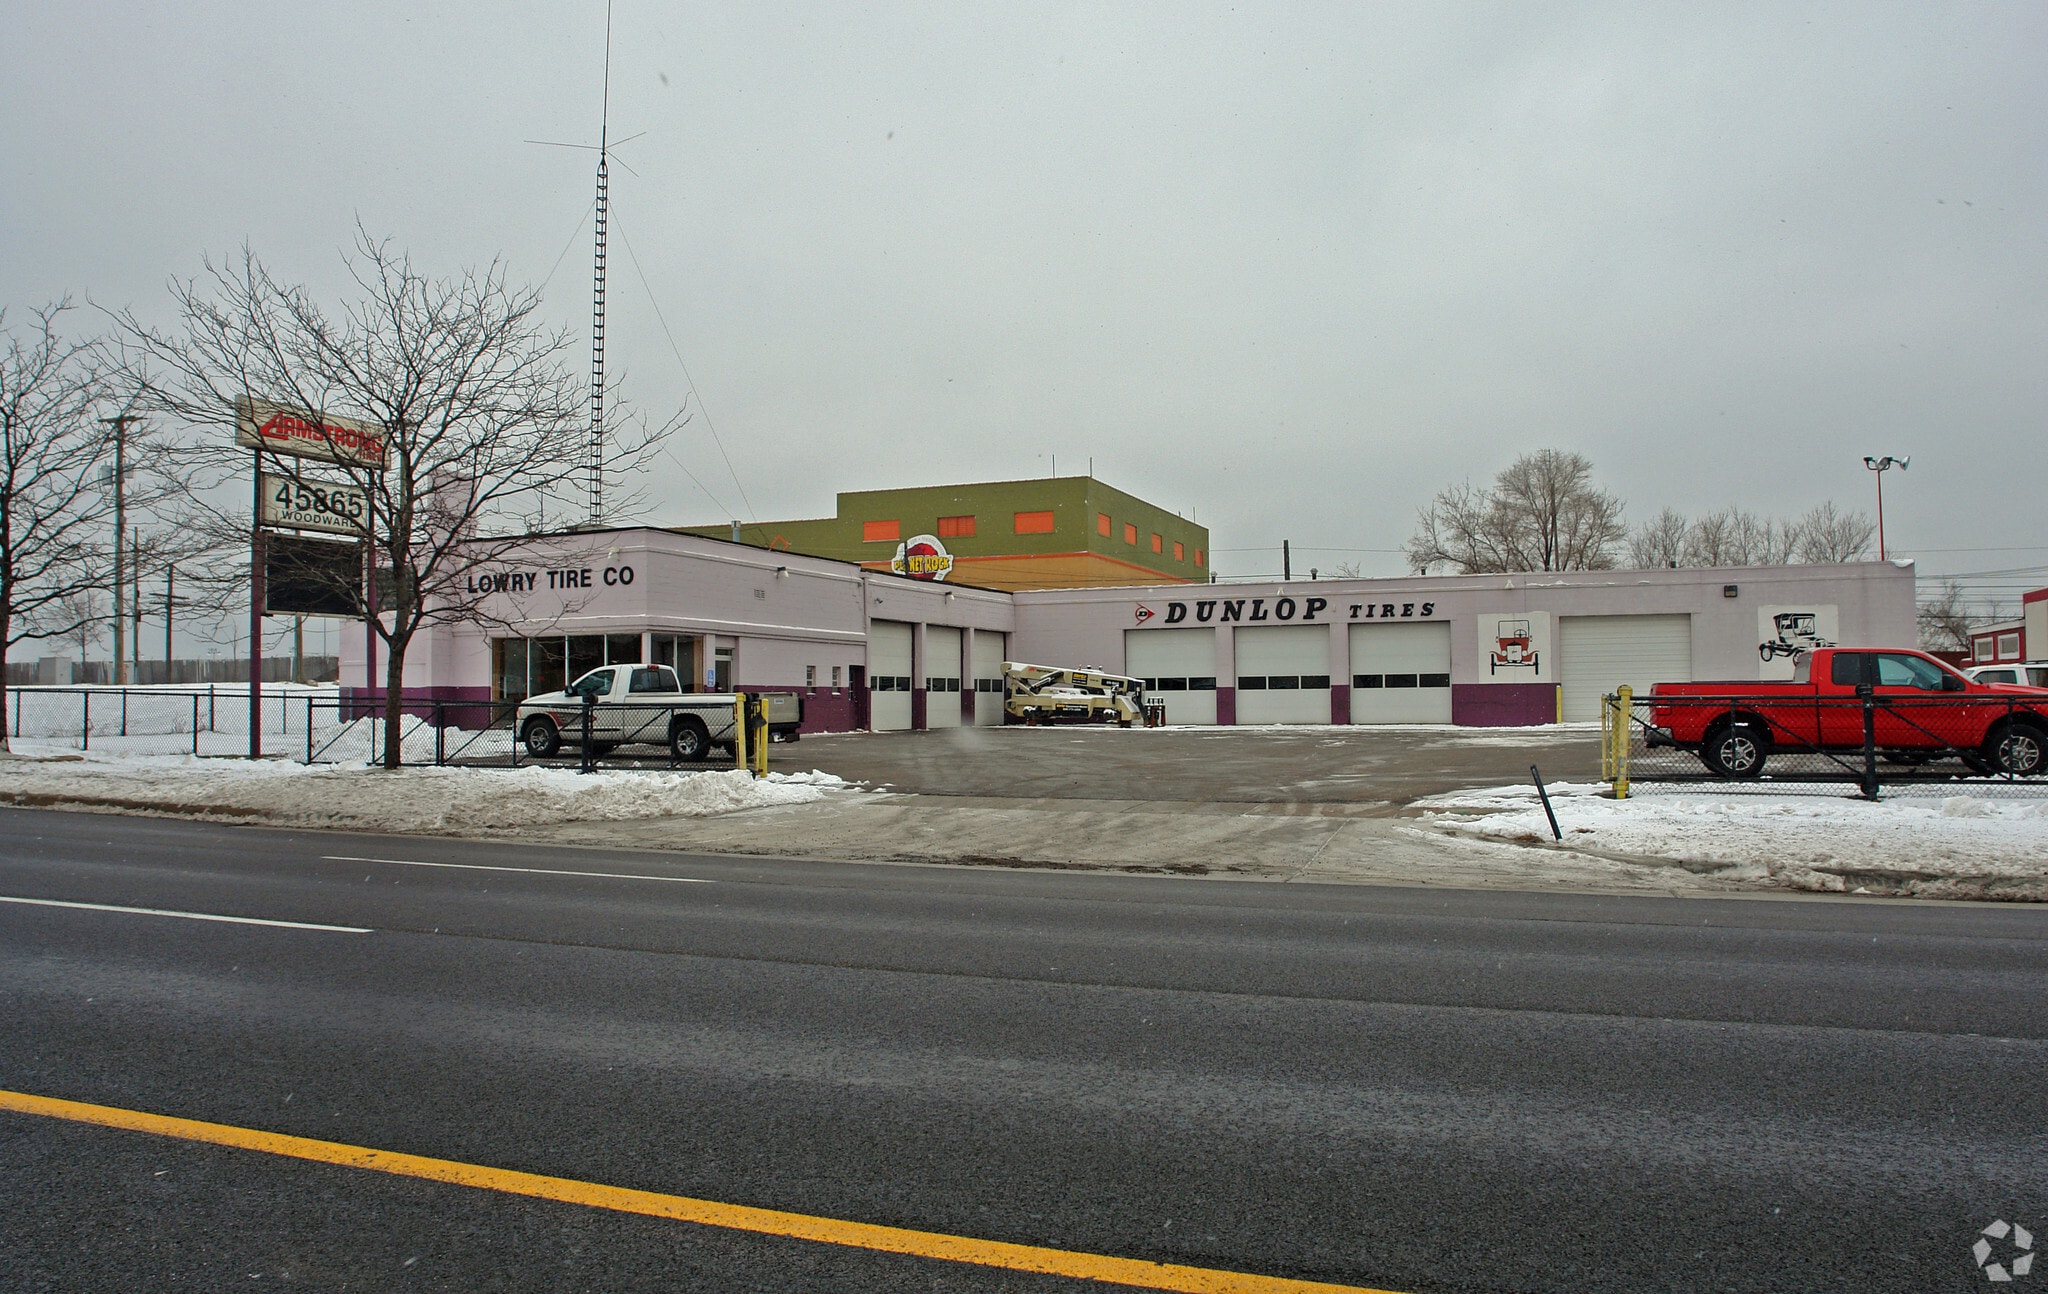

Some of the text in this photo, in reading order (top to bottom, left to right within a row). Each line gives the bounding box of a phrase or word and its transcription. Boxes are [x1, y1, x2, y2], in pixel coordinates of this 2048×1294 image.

[260, 411, 382, 452] ARMSTRONG
[275, 483, 362, 518] 45865
[894, 555, 950, 572] PLNET ROCK
[467, 566, 634, 594] LOWRY TIRE CO
[1165, 598, 1435, 623] DUNLOP TIRES
